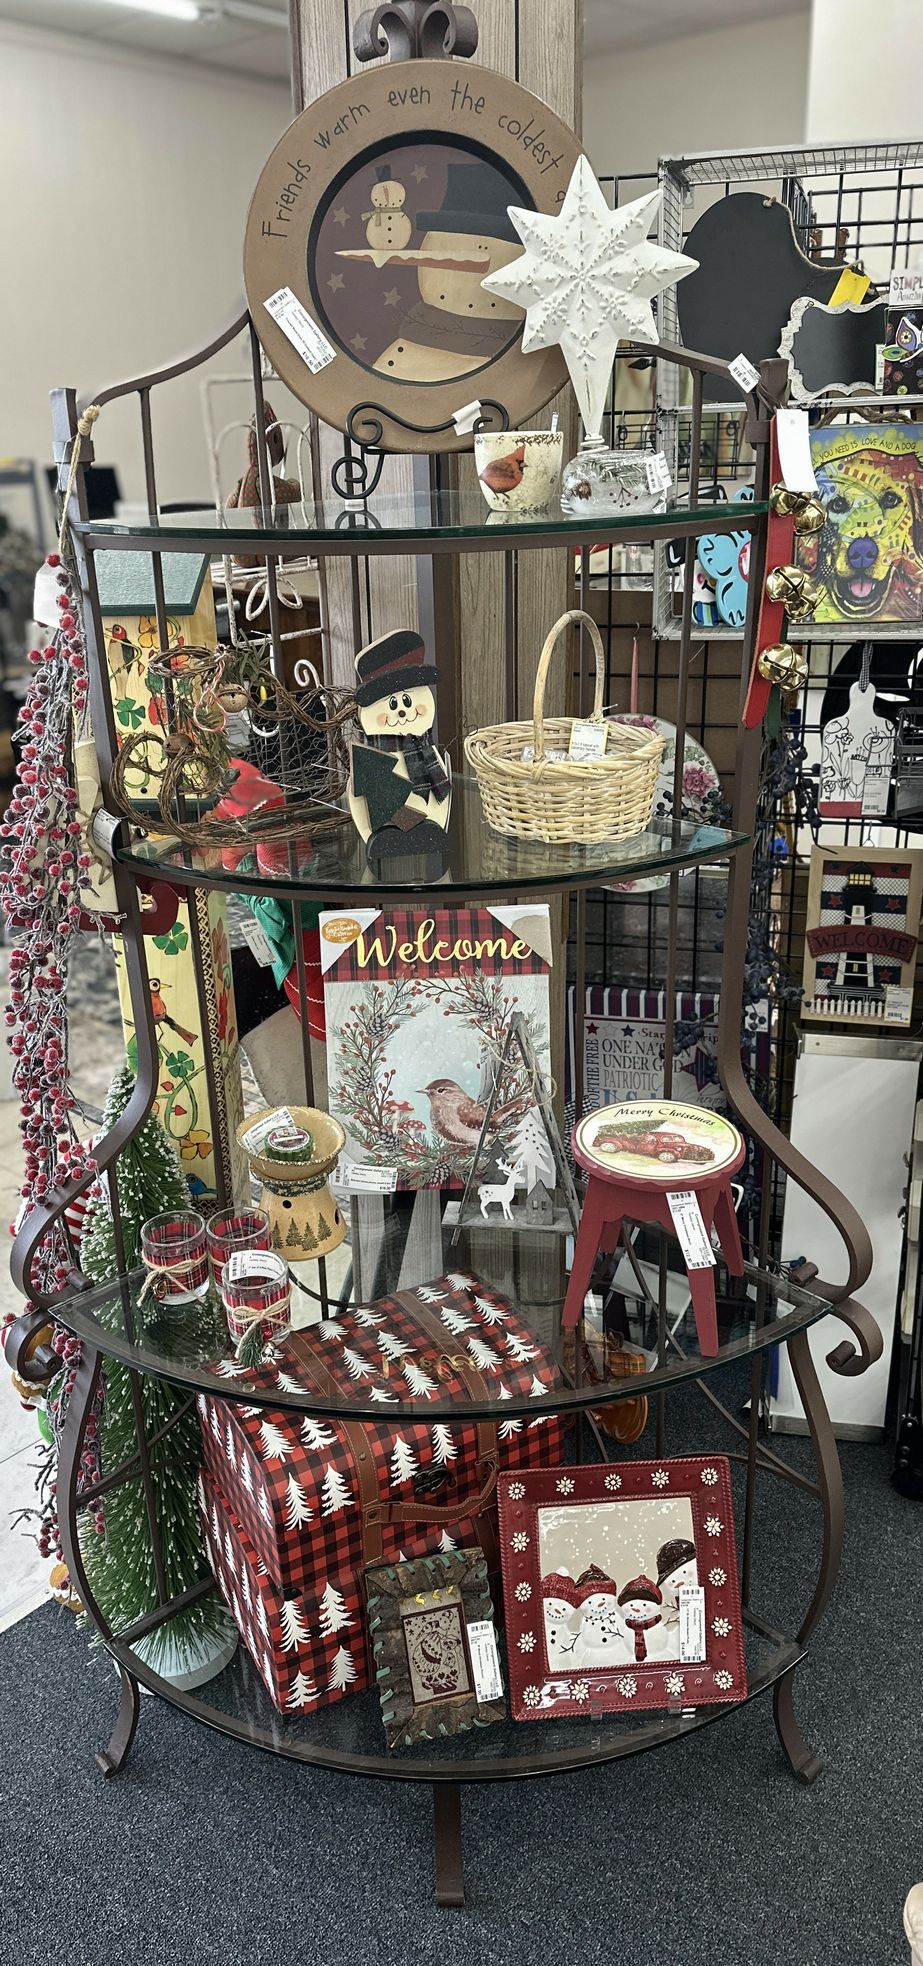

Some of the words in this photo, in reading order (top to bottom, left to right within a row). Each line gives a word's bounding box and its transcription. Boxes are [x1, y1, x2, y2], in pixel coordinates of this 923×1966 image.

[261, 158, 312, 239] Friends
[313, 102, 371, 151] warm
[387, 85, 432, 106] even
[450, 80, 486, 114] the
[497, 113, 565, 174] coldest
[298, 309, 314, 331] Consignment
[819, 449, 833, 460] YOU
[835, 444, 849, 454] NEED
[850, 440, 858, 449] IS
[861, 437, 877, 446] LOVE
[879, 439, 893, 450] AND
[895, 443, 900, 451] A
[356, 918, 533, 968] Welcome
[814, 931, 909, 954] WELCOME
[586, 1039, 599, 1065] FREE
[602, 1039, 632, 1054] ONE
[602, 1054, 650, 1071] UNDER
[652, 1058, 683, 1073] GD
[587, 1067, 600, 1086] THE
[604, 1070, 659, 1091] PATRIOTIC
[614, 1107, 654, 1118] Merry
[658, 1108, 716, 1126] Christmas
